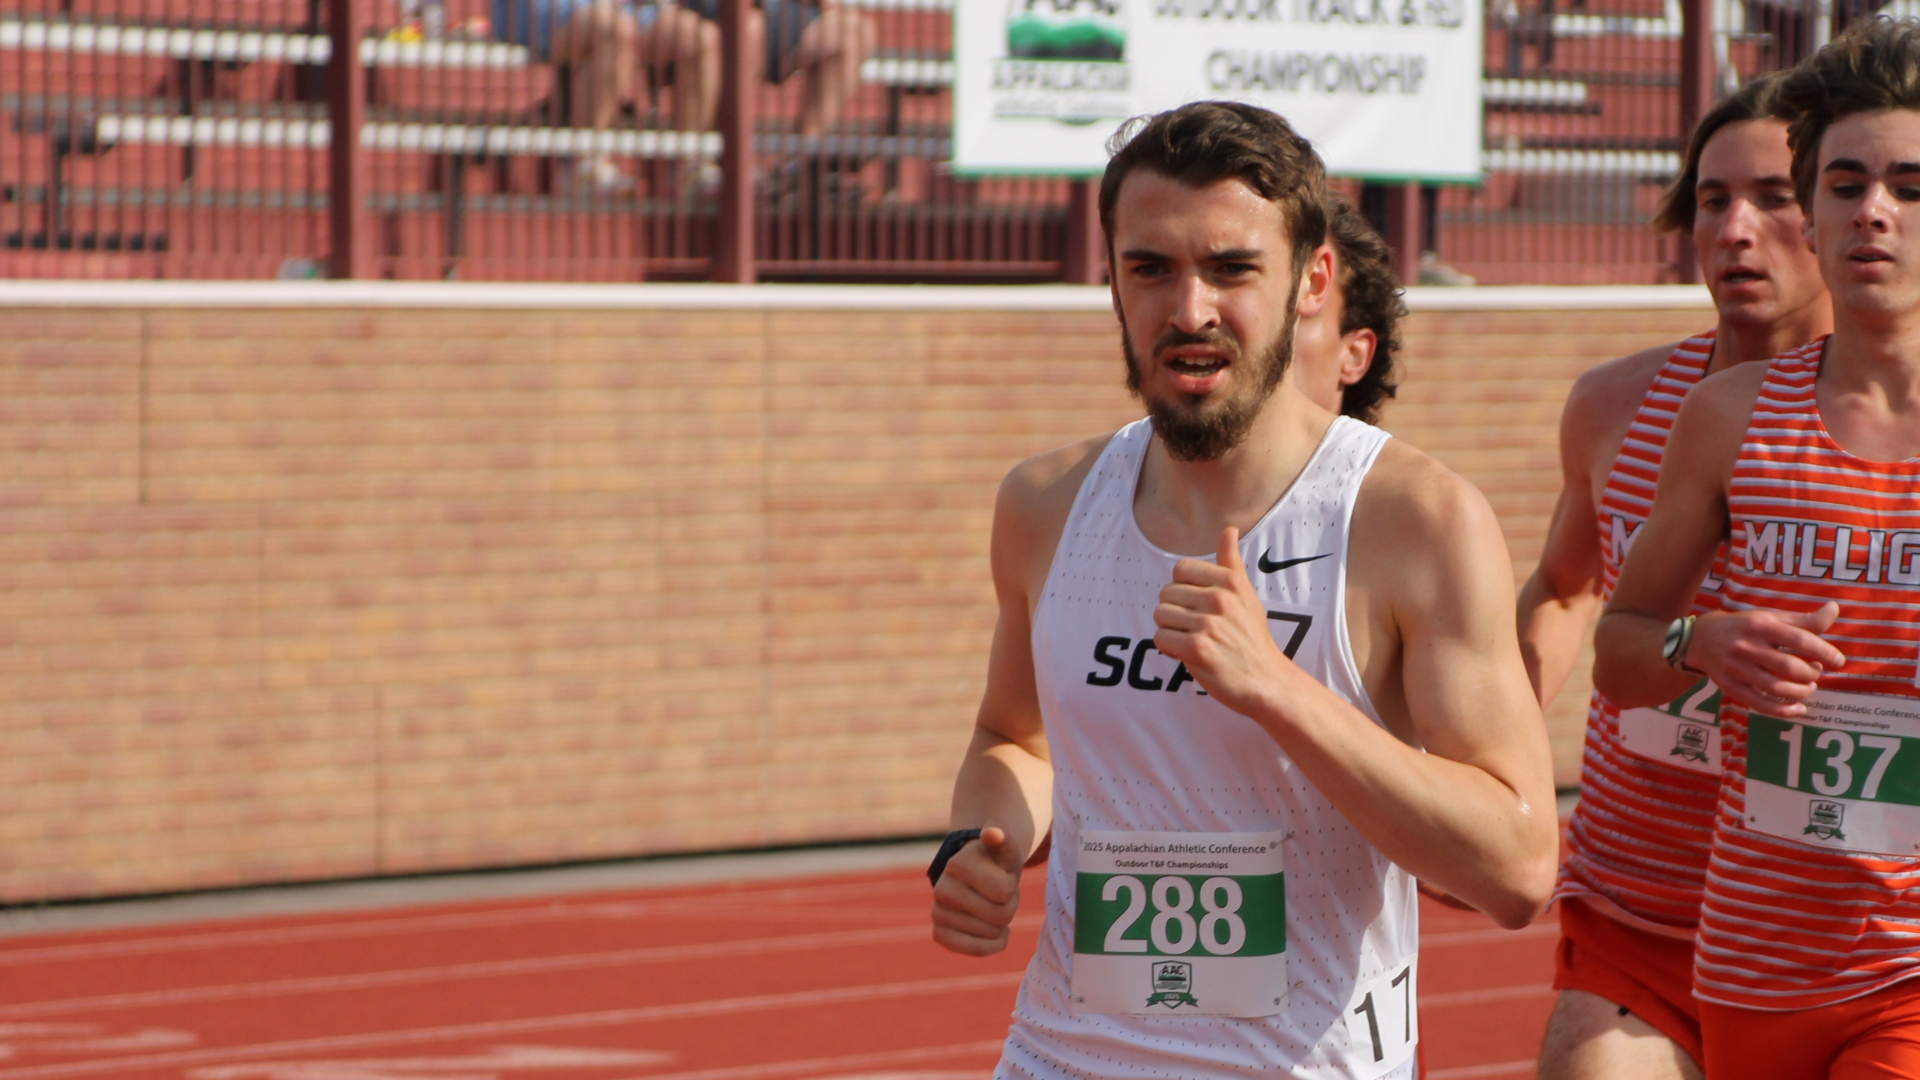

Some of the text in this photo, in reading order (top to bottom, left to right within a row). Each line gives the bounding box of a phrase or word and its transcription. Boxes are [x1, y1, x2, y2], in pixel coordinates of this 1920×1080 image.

[1802, 700, 1835, 711] lachian
[1837, 703, 1873, 715] Athletic
[1820, 715, 1833, 723] T&F
[1834, 717, 1890, 730] Championships
[1779, 724, 1901, 799] 137
[1817, 803, 1838, 814] AAC
[1084, 842, 1266, 855] 2025 Appalachian Athletic Conference
[1115, 860, 1148, 868] Outdoor
[1167, 860, 1228, 869] Championships
[1101, 874, 1247, 956] 288
[1161, 964, 1184, 976] AAC
